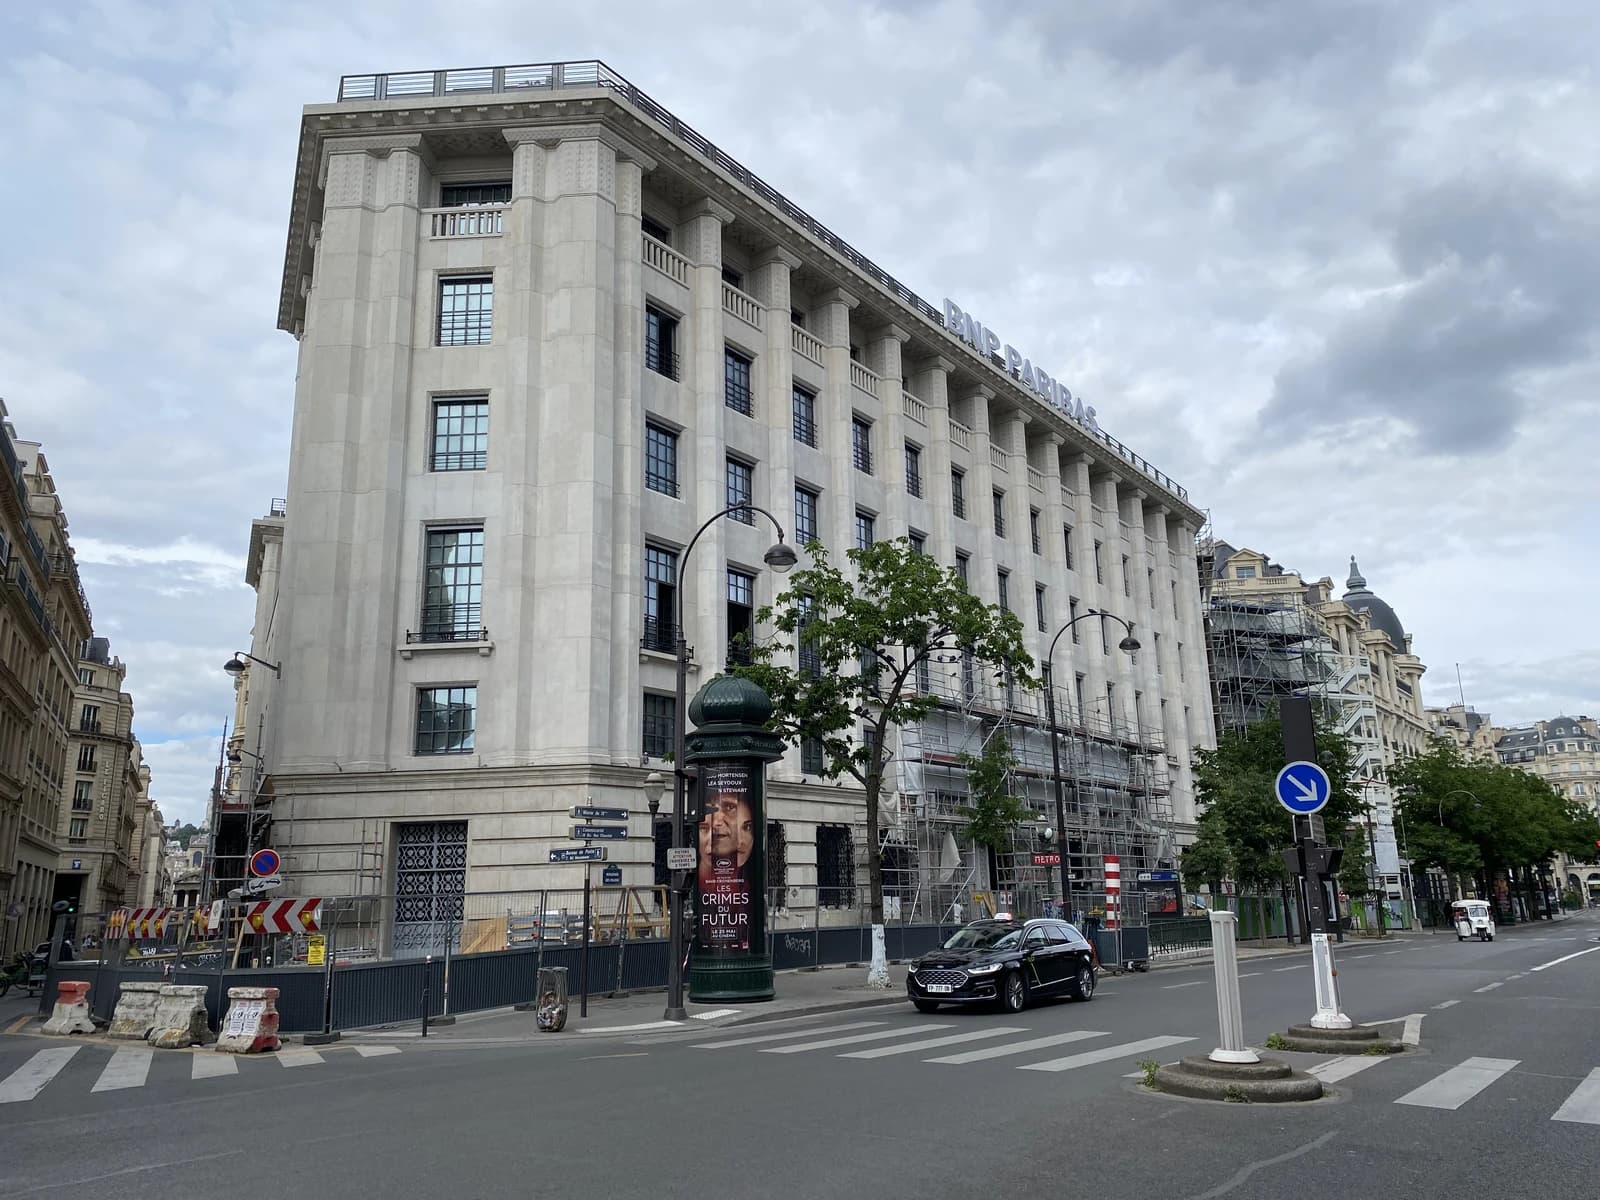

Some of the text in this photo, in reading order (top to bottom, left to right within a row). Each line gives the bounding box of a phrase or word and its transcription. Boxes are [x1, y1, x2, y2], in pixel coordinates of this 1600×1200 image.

[943, 298, 1099, 434] BNP PARIBAS
[716, 884, 731, 892] LES
[702, 892, 749, 905] CRIMES
[717, 905, 730, 913] DU
[702, 913, 748, 926] FUTUR
